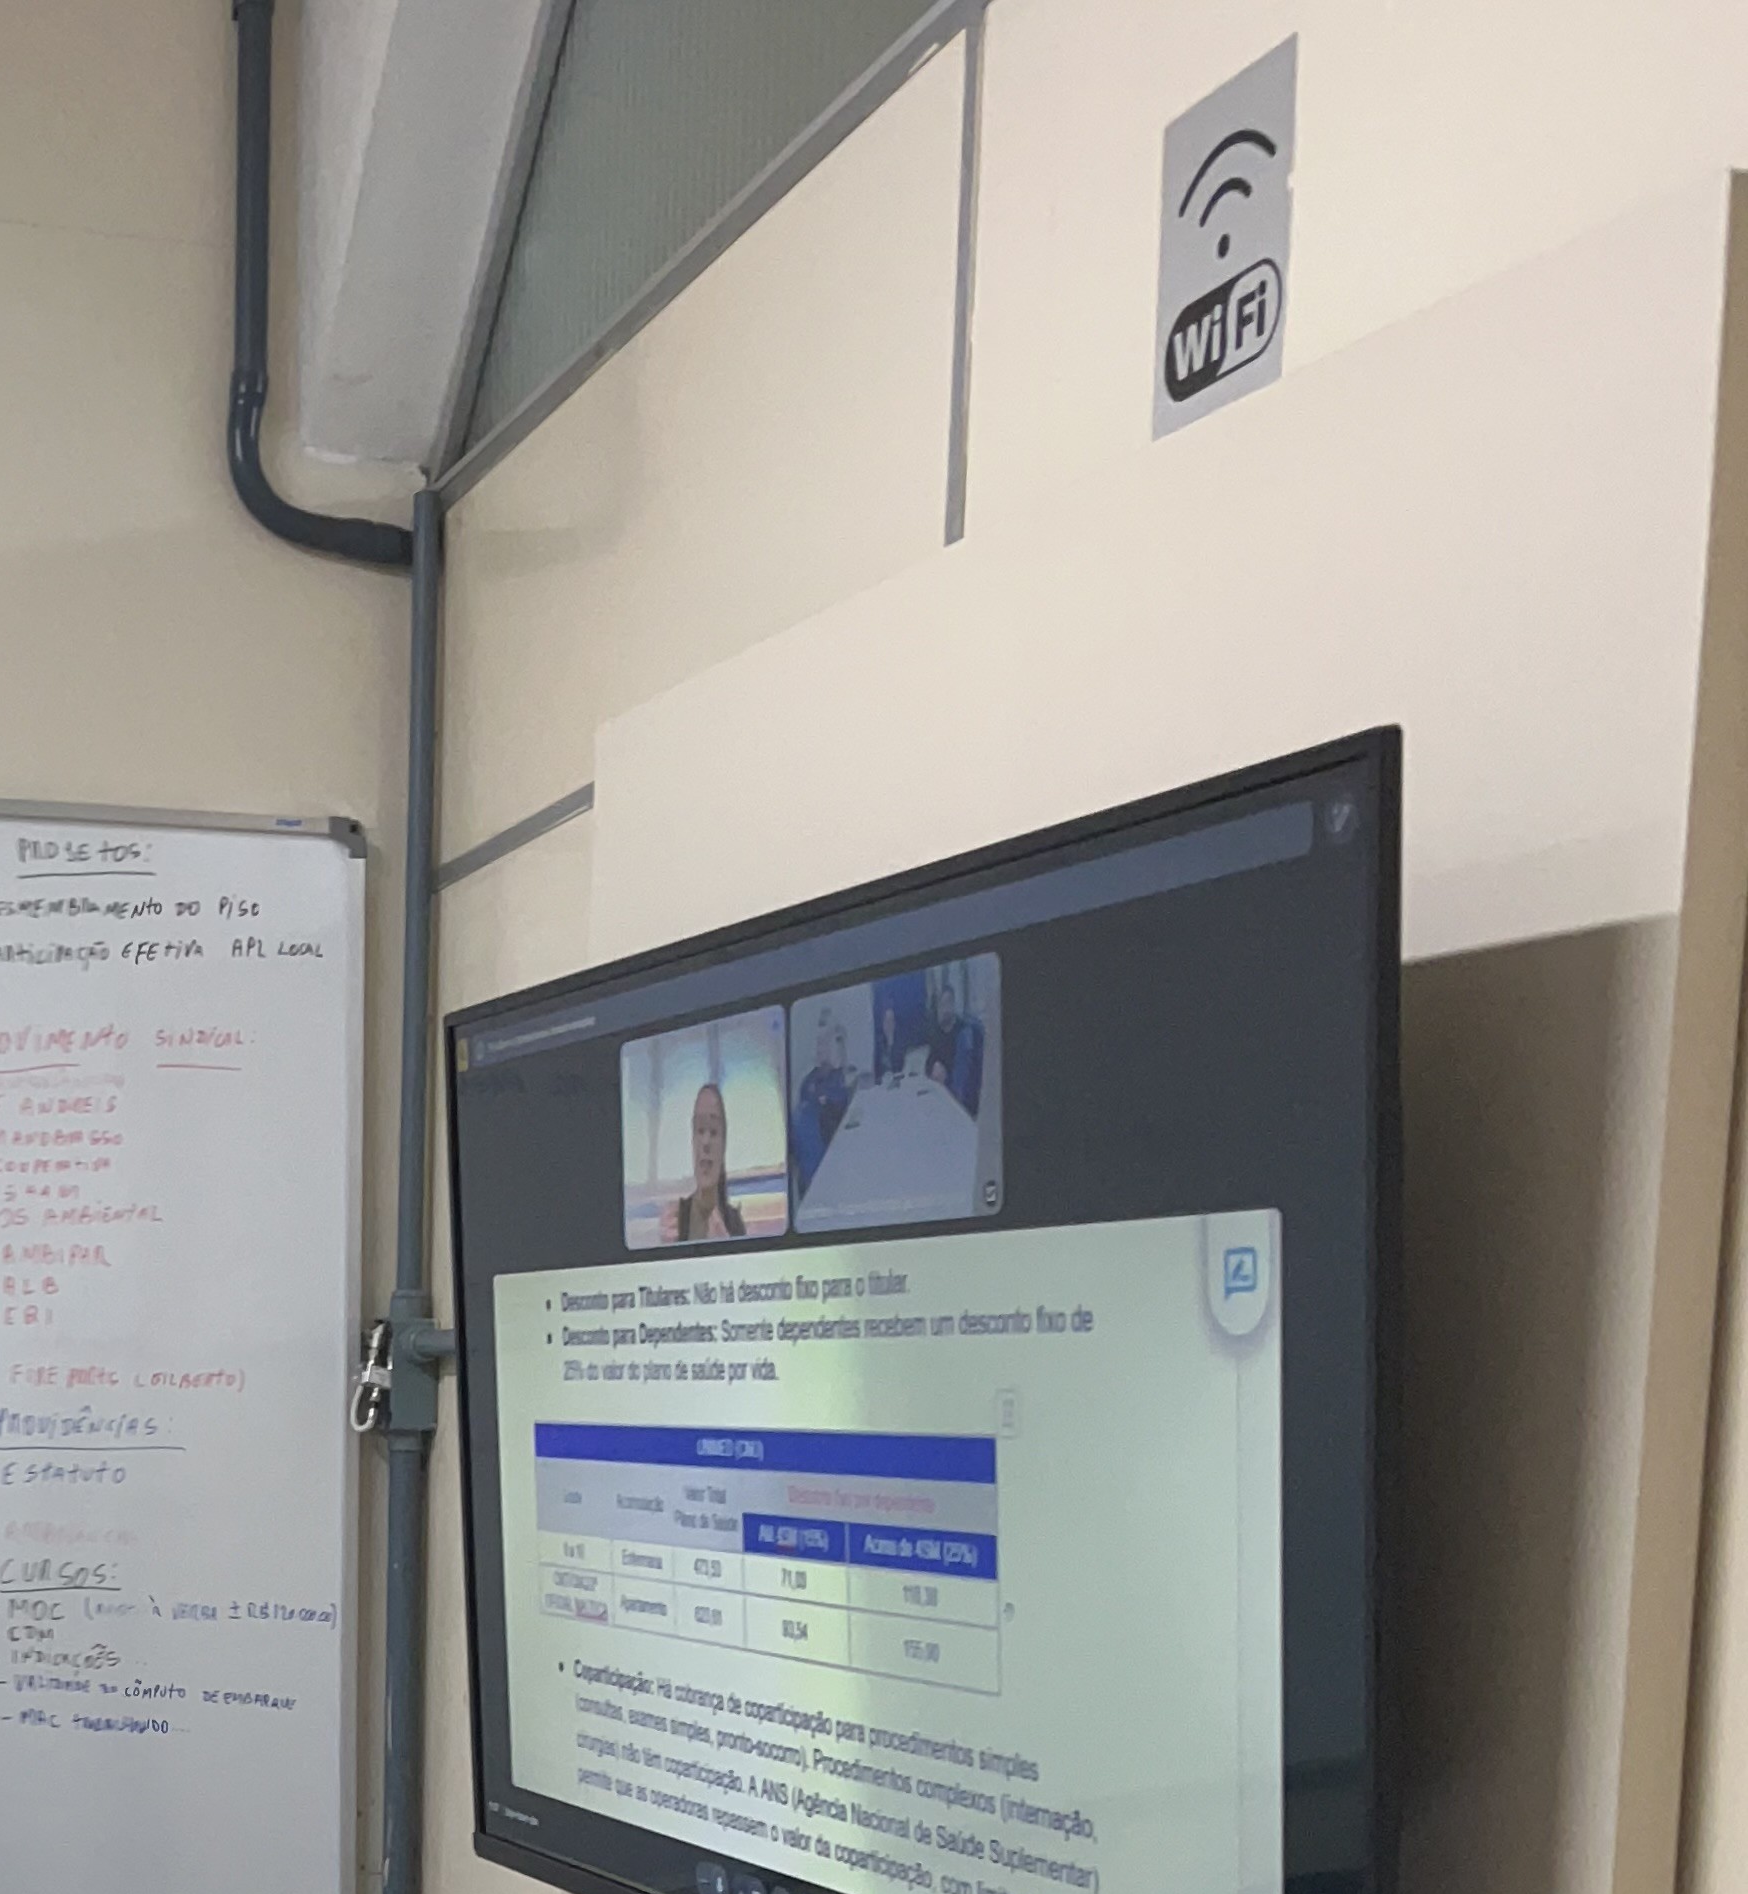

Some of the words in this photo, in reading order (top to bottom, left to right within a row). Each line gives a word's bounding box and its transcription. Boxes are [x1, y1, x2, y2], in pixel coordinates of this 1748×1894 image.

[1173, 280, 1268, 382] WiFi
[2, 1274, 60, 1296] ALB
[694, 1281, 717, 1304] Não
[738, 1277, 792, 1302] desconto
[822, 1277, 851, 1303] para
[777, 1314, 860, 1346] dependentes
[959, 1308, 1031, 1335] desconto
[1072, 1304, 1093, 1333] de
[727, 1693, 741, 1714] de
[745, 1701, 832, 1738] coparticipação
[836, 1720, 865, 1743] para
[869, 1727, 973, 1767] procedimentos
[813, 1748, 911, 1793] Procedimentos
[748, 1775, 758, 1798] A
[760, 1777, 788, 1805] ANS
[792, 1786, 847, 1822] (Agência
[851, 1802, 910, 1839] Nacional
[914, 1820, 932, 1845] de
[936, 1824, 984, 1860] Saúde
[782, 1827, 811, 1852] valor
